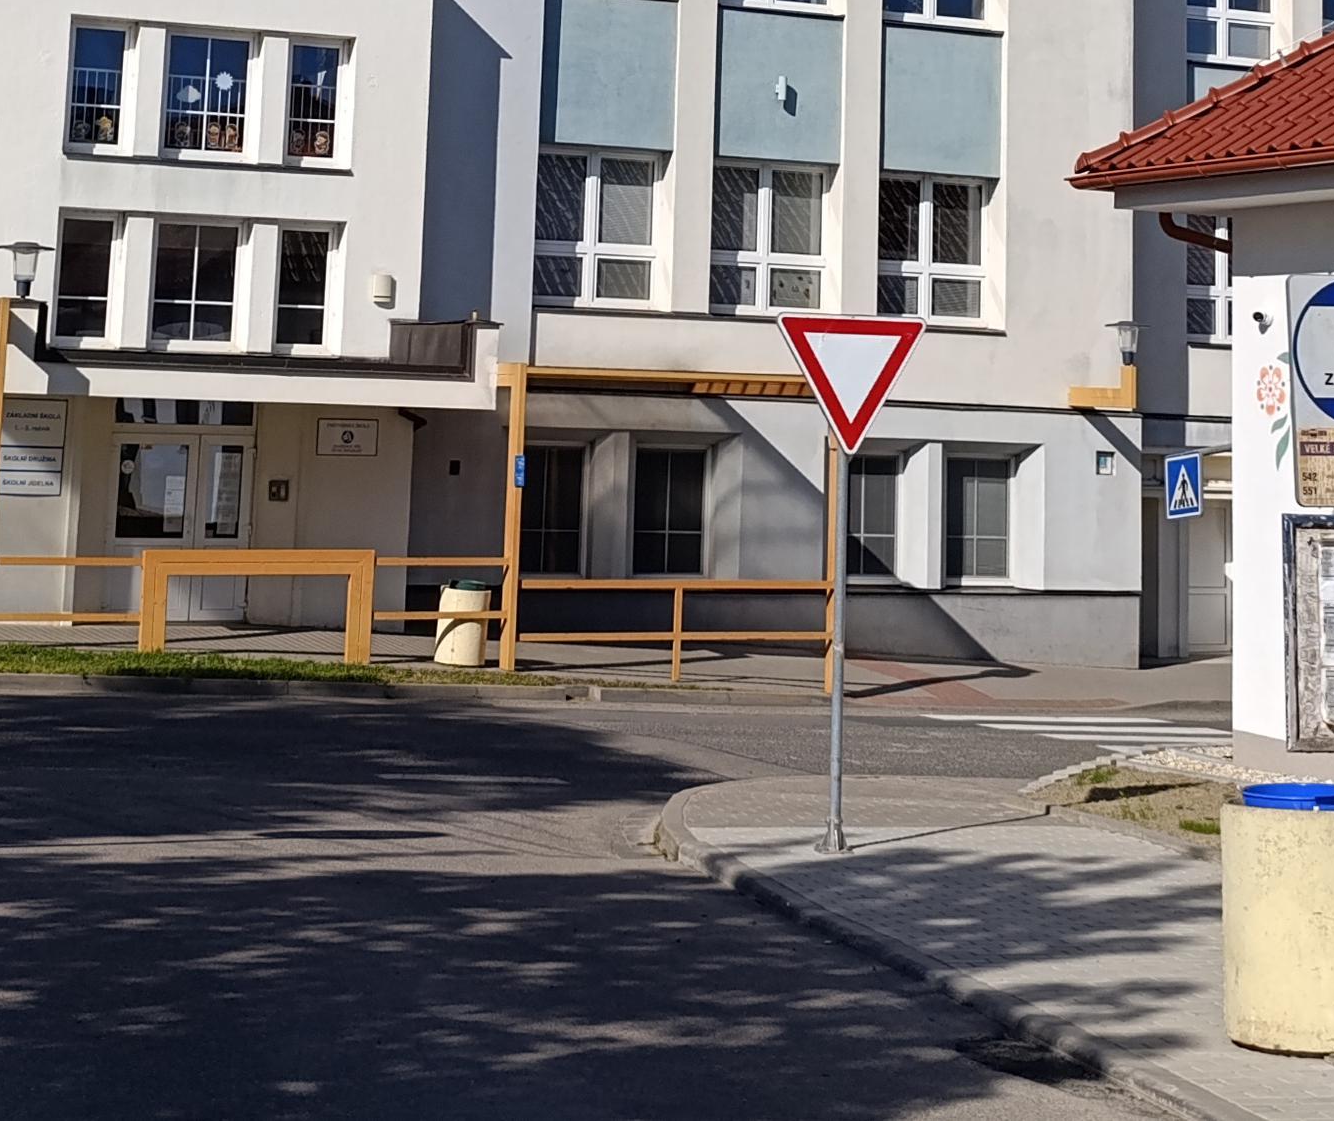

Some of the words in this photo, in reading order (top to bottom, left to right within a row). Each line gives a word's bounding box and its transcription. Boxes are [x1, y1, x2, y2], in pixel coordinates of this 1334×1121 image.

[1304, 442, 1331, 454] VELKÉ
[1302, 472, 1317, 481] 542
[1302, 486, 1317, 495] 551
